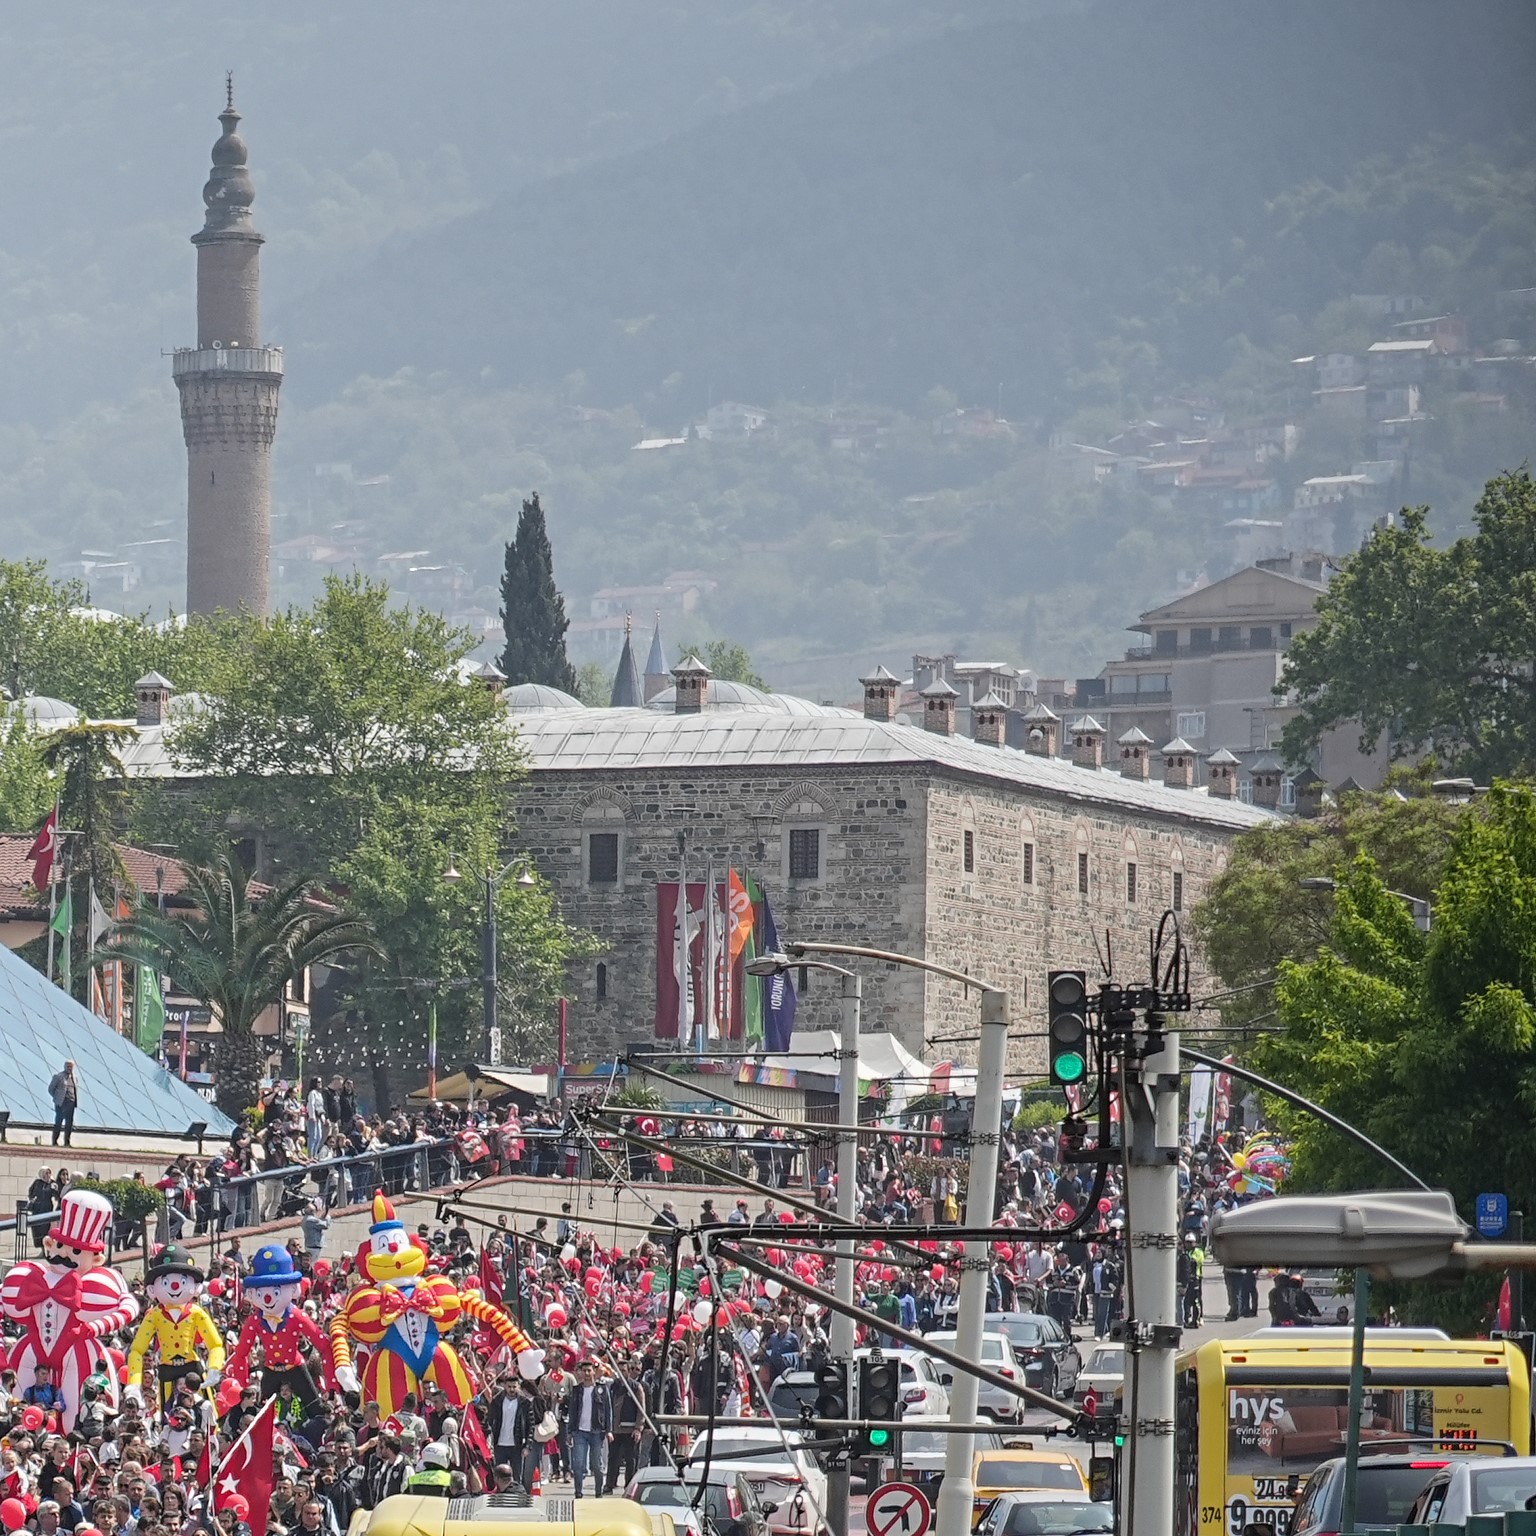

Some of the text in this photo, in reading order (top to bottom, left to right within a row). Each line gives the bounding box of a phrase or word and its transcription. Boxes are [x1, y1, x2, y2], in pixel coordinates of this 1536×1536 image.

[1229, 1389, 1285, 1425] hys
[1235, 1426, 1278, 1436] eviniz için
[1241, 1436, 1257, 1446] her
[1201, 1506, 1222, 1524] 374
